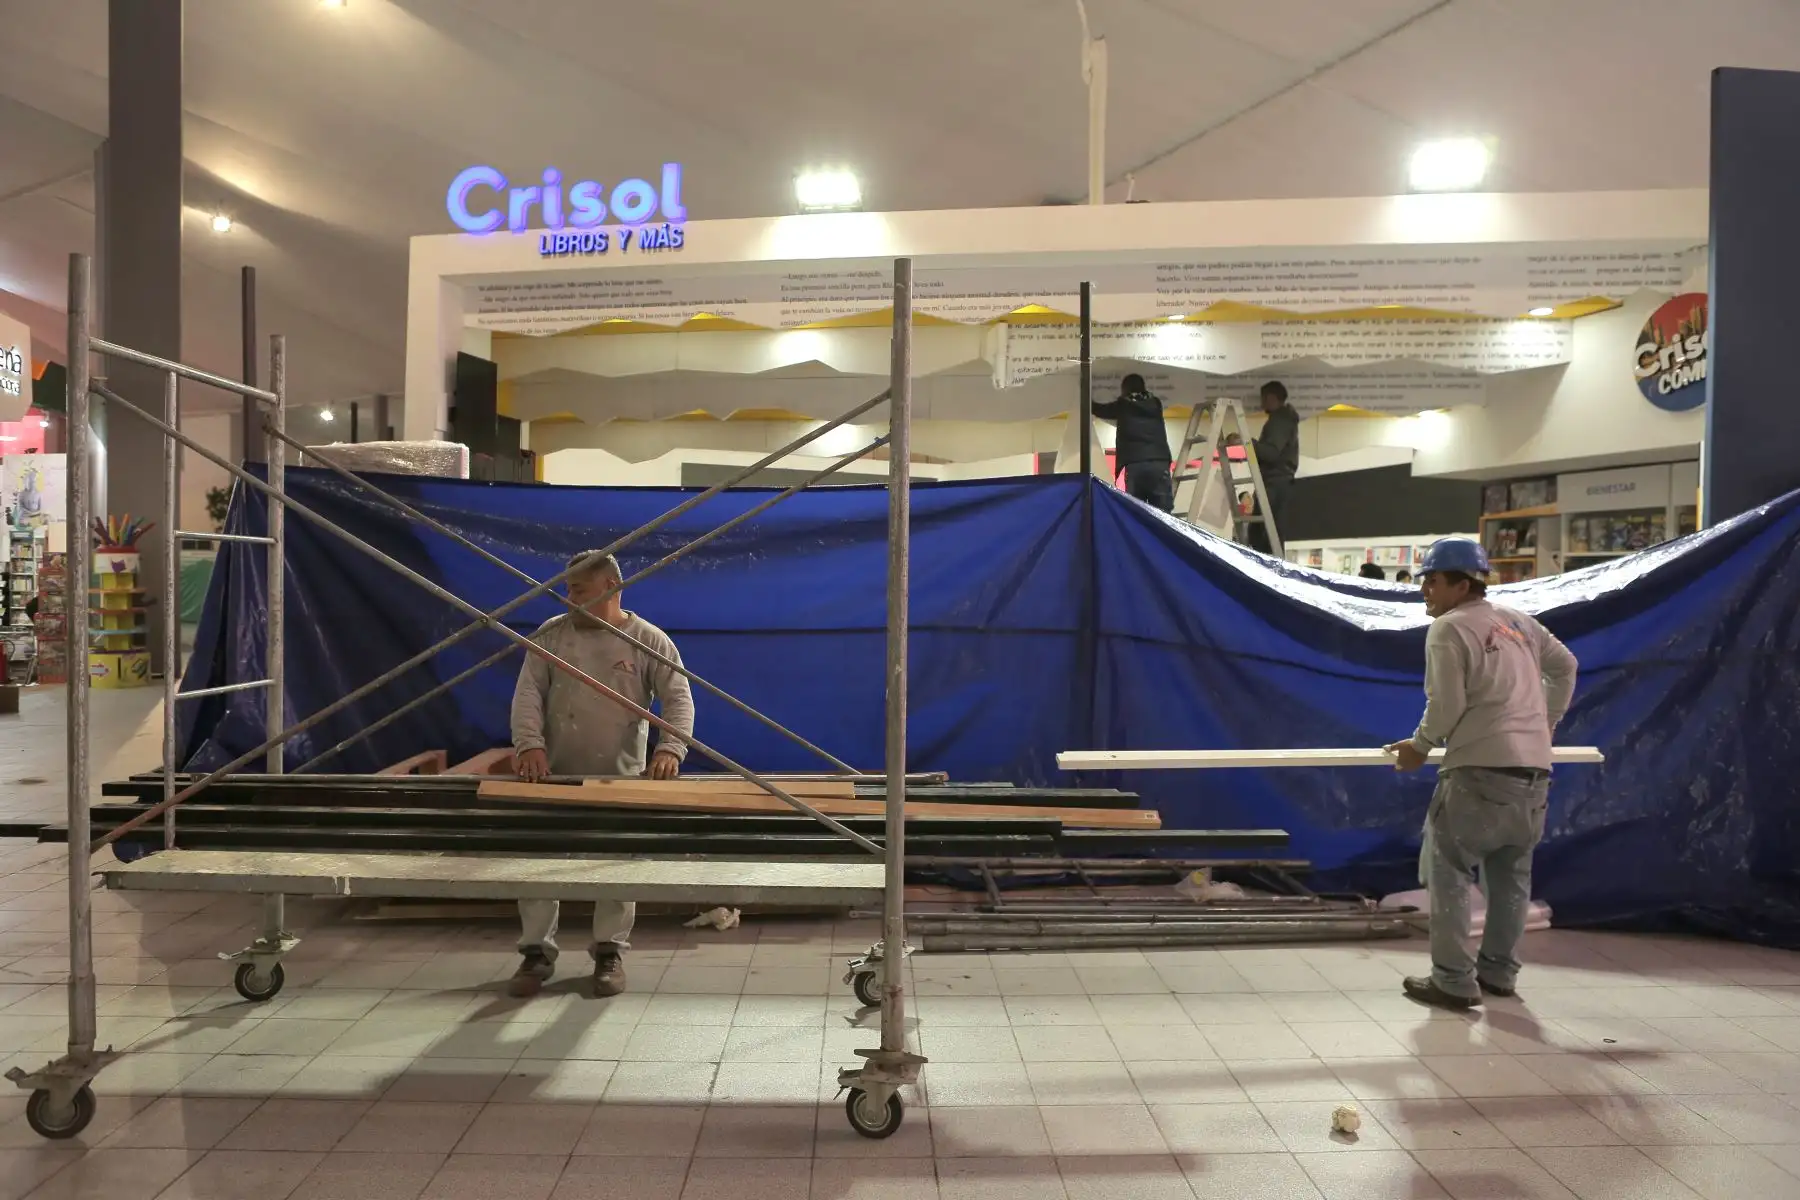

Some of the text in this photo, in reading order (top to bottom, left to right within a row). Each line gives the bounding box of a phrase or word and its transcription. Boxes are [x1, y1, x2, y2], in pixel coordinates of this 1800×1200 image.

[446, 162, 685, 234] Crisol
[538, 223, 684, 256] LIBROS Y MÁS
[1633, 331, 1708, 377] Cris
[1586, 482, 1636, 495] BIENESTAR
